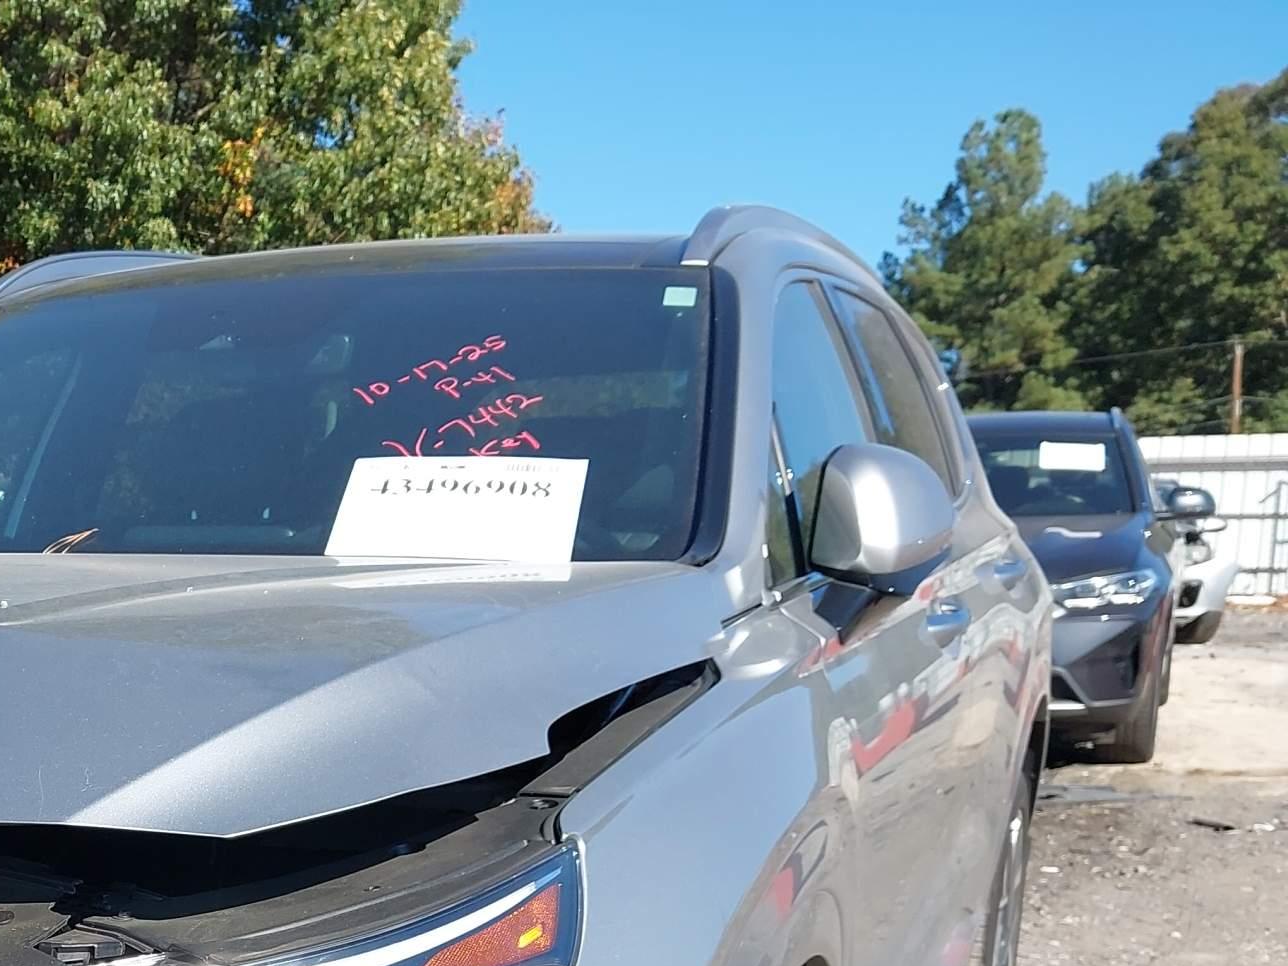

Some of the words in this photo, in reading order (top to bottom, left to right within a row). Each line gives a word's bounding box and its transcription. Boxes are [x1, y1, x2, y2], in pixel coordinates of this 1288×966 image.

[352, 334, 507, 405] 10-17-25
[433, 366, 516, 399] P-41
[370, 478, 552, 497] 43496908
